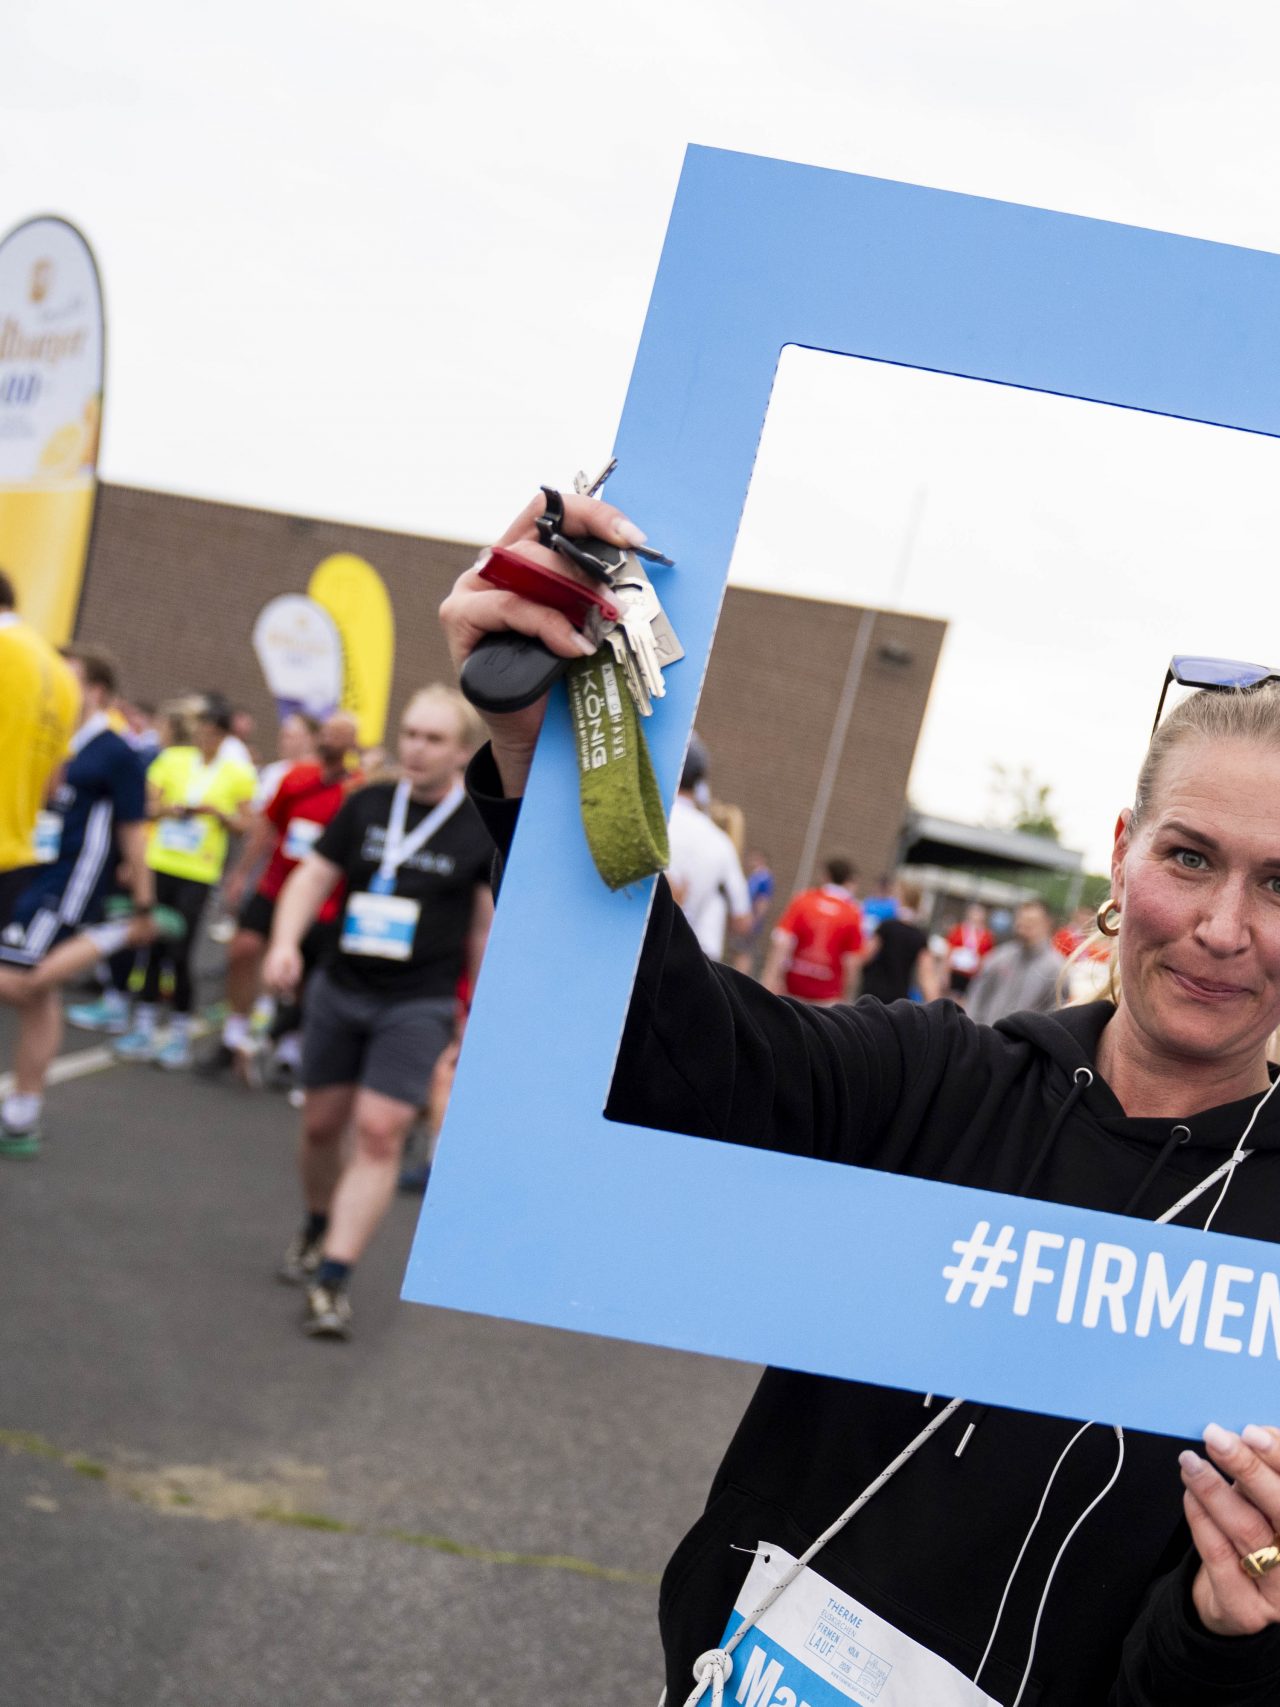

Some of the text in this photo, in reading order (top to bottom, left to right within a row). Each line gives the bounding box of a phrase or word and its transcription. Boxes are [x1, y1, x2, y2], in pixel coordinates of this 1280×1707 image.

[581, 670, 607, 769] KÖNIG
[827, 1598, 863, 1629] THERME
[808, 1633, 835, 1656] LAUF
[817, 1622, 840, 1644] FIRMEN
